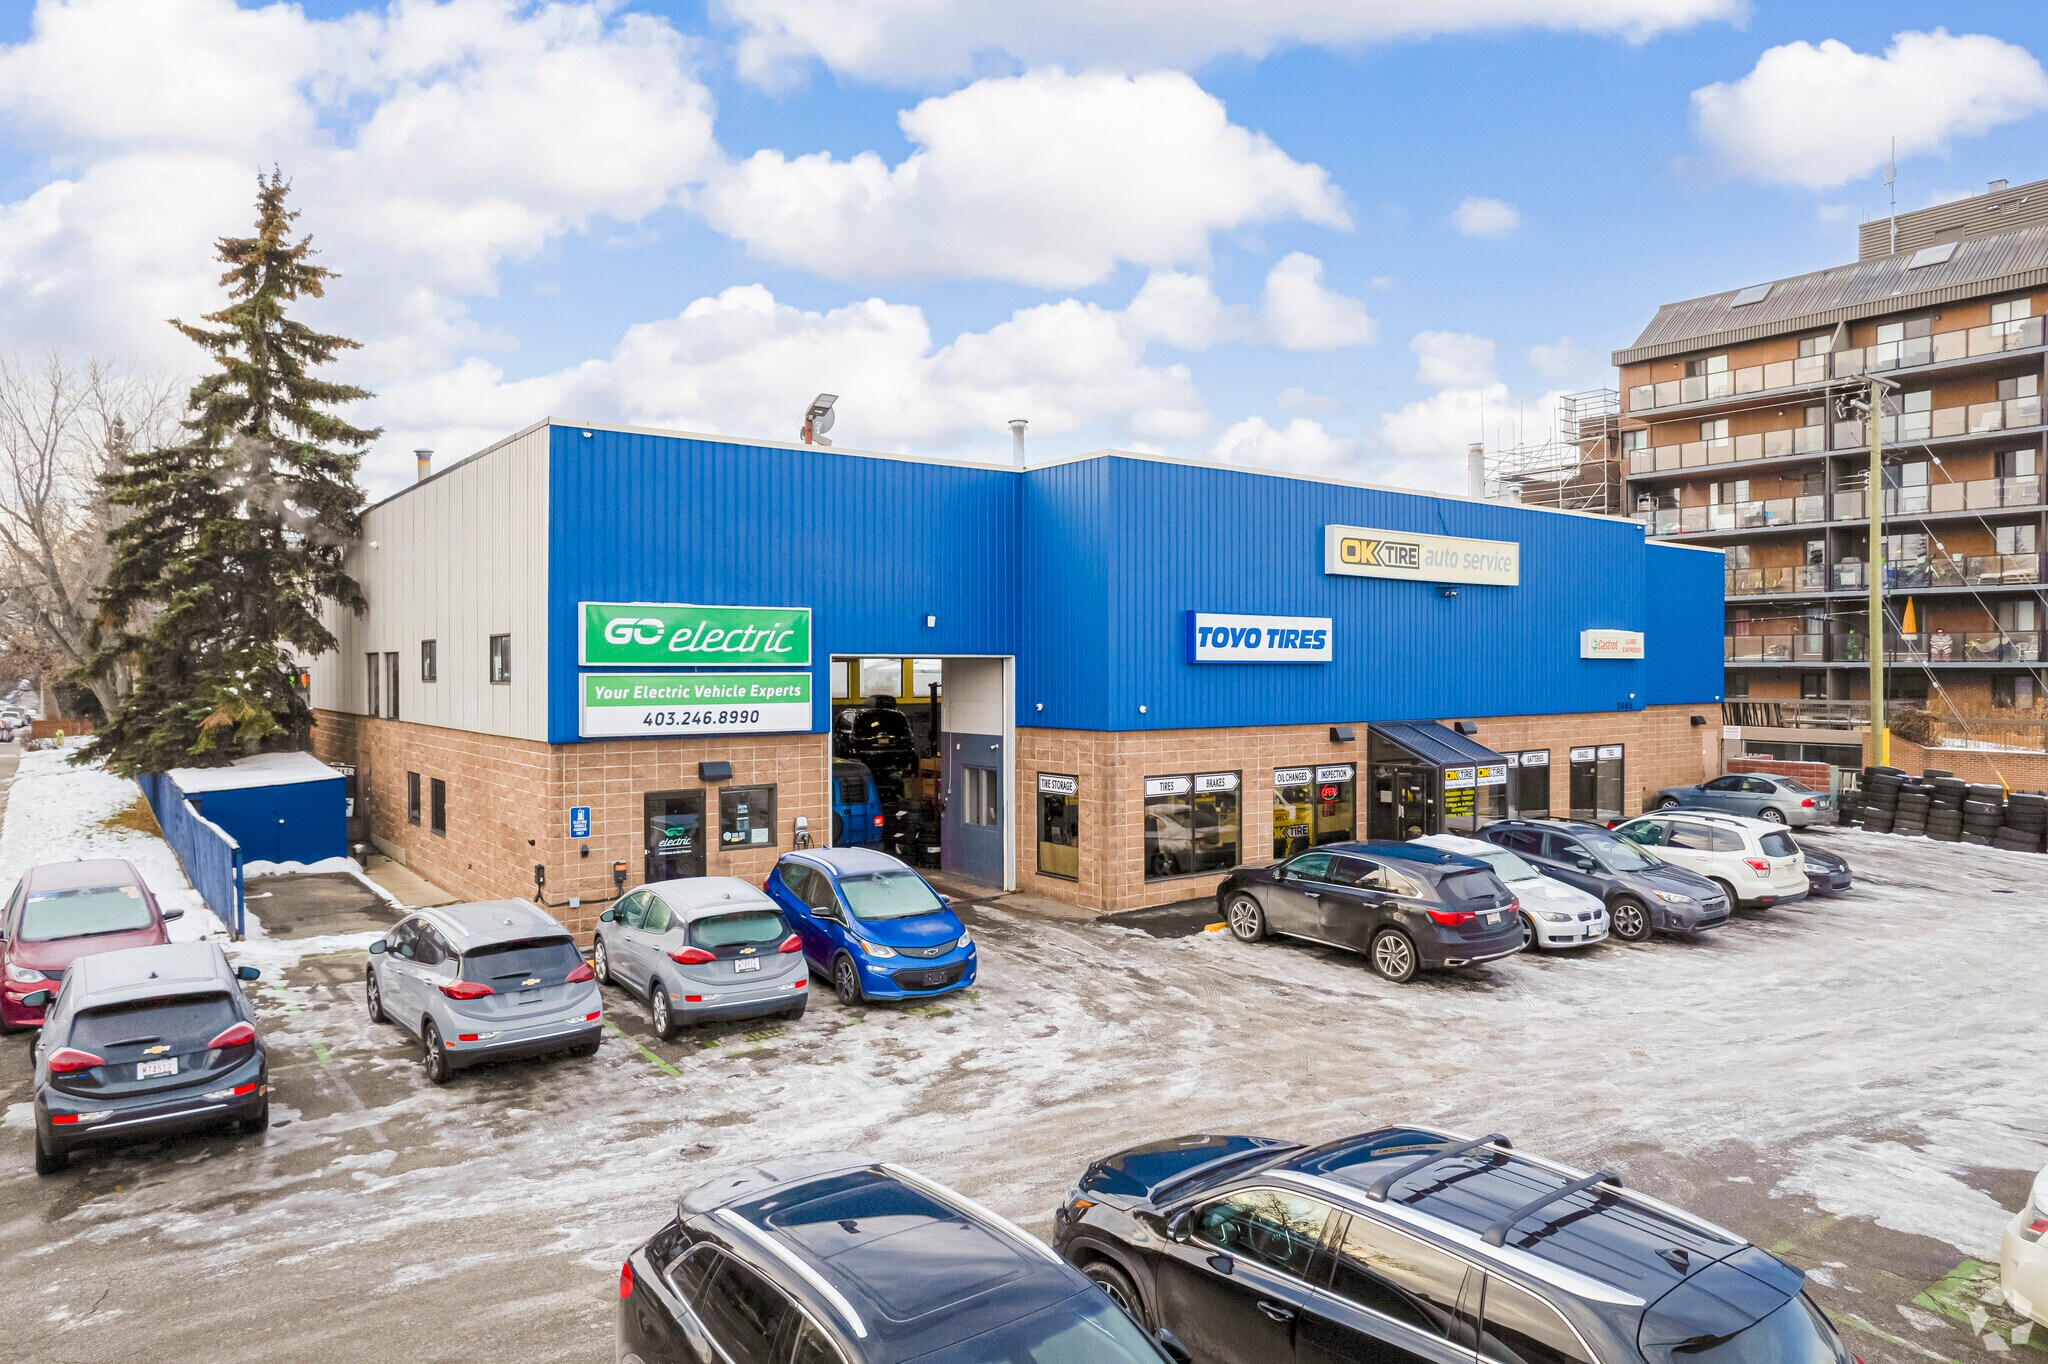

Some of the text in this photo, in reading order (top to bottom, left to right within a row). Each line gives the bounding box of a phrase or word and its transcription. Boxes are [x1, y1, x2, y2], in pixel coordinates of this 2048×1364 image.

[1341, 538, 1512, 573] OK TIRE auto service
[604, 617, 795, 653] GO electric
[1198, 626, 1327, 650] TOYO TIRES
[1597, 639, 1619, 651] Castrol
[1621, 646, 1642, 654] EXPRESS
[595, 684, 802, 700] Your Electric Vehicle Experts
[642, 709, 760, 727] 403.246.8990
[1527, 754, 1544, 763] BATTERIES
[1277, 771, 1308, 783] OIL CHANGES
[1320, 769, 1347, 780] INSPECTION
[1445, 770, 1473, 781] OK TIRE
[1477, 767, 1504, 778] OK TIRE
[1041, 778, 1073, 791] TIRE STORAGE
[1159, 781, 1174, 792] TIRES
[1206, 777, 1226, 788] BRAKES
[1321, 787, 1338, 797] OPEN
[666, 827, 685, 837] GO
[1290, 825, 1308, 837] TIRE
[659, 836, 691, 847] electric
